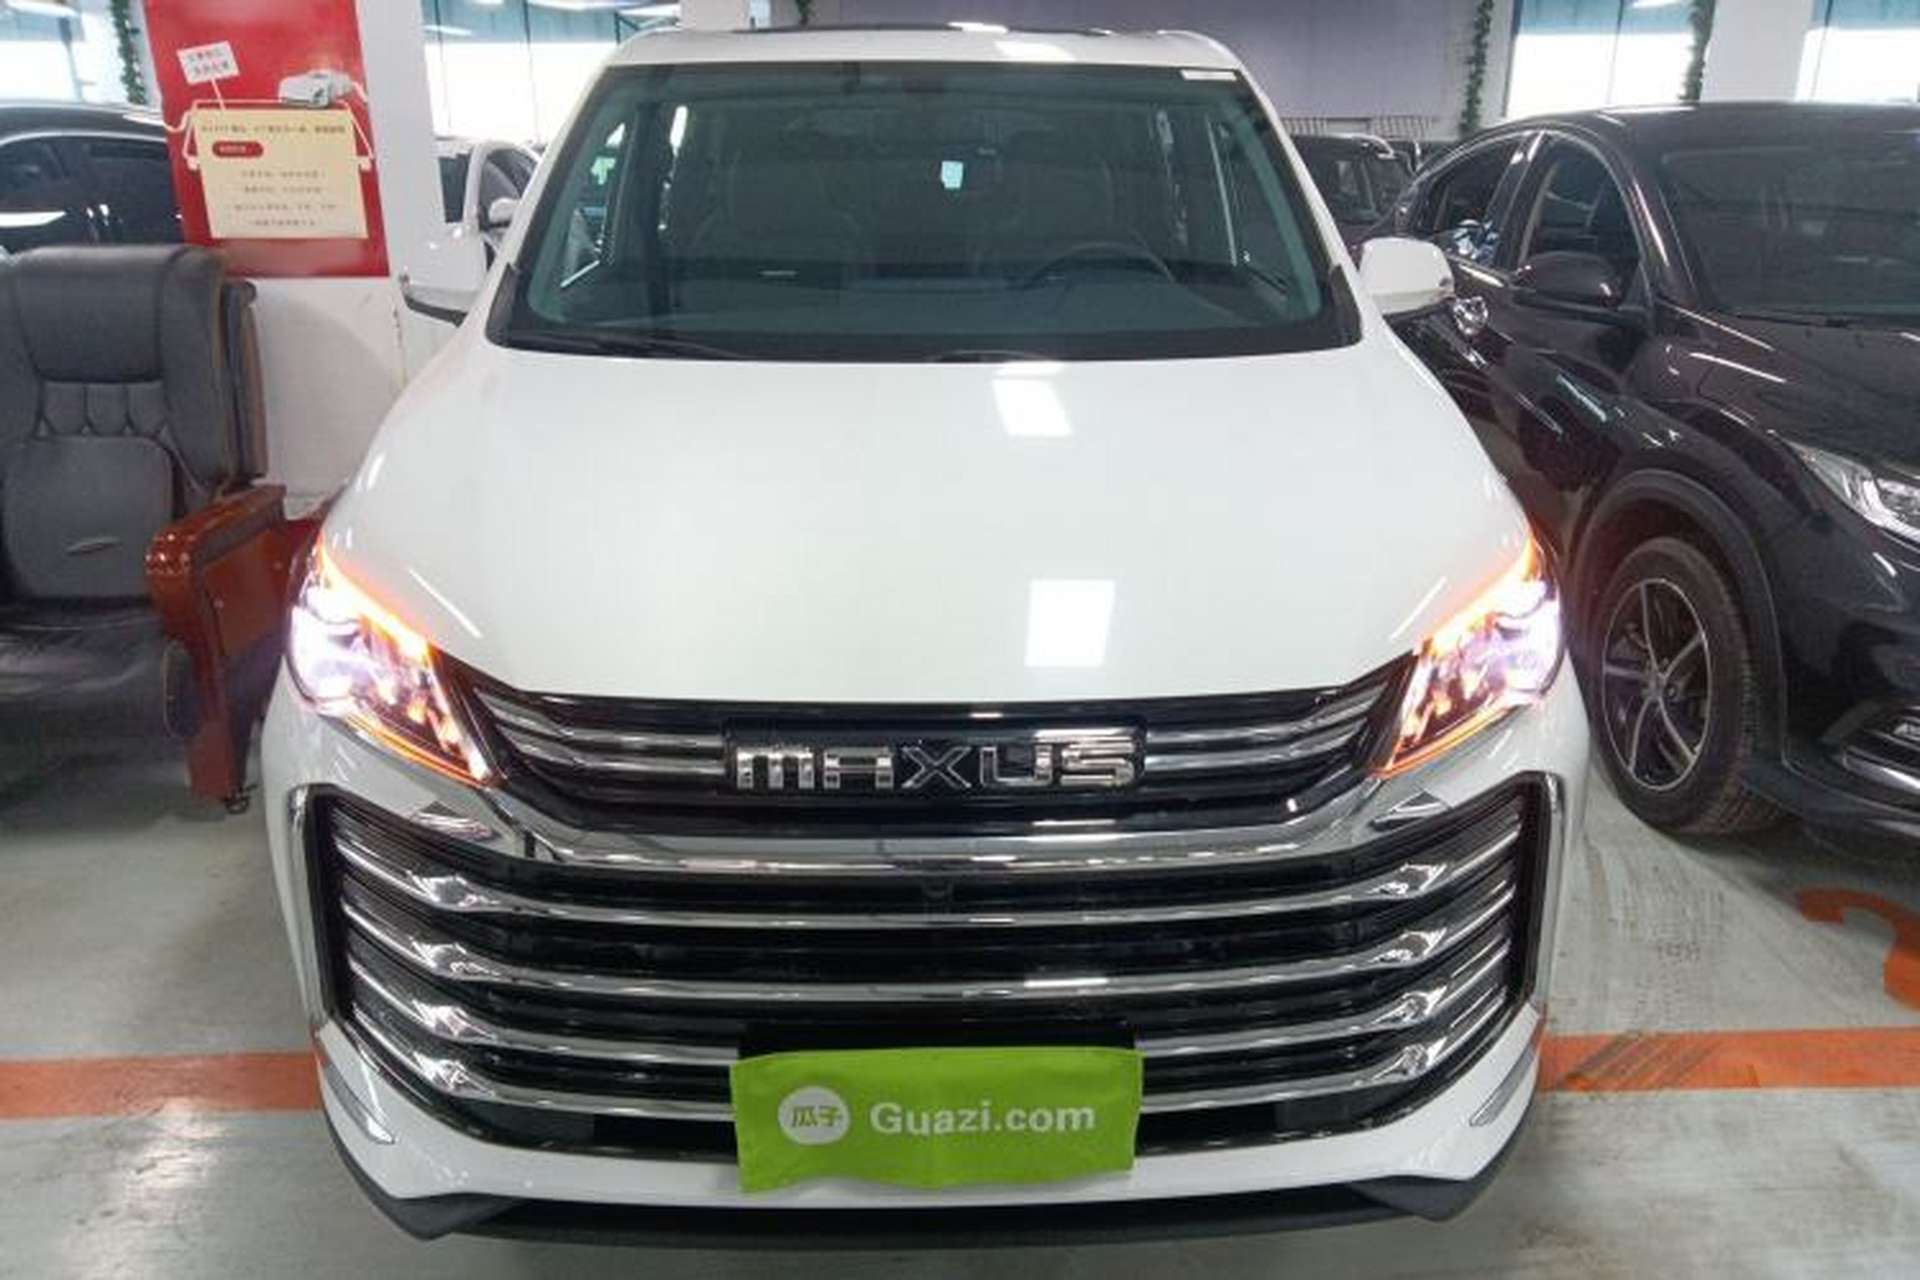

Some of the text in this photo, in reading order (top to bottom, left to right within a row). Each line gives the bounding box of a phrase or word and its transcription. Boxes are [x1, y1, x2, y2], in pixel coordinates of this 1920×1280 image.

[735, 728, 1137, 791] MAXUS
[791, 1105, 844, 1128] 瓜子
[869, 1100, 1095, 1135] Guazi.com
